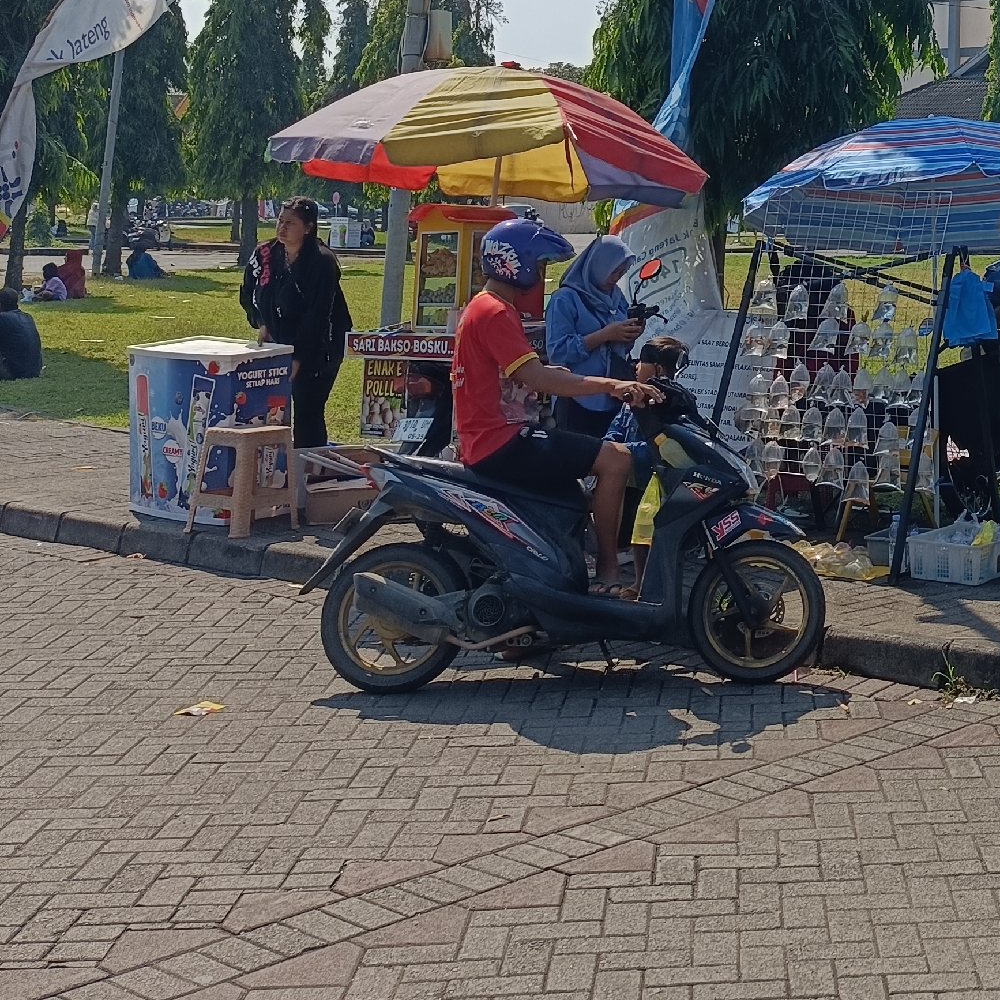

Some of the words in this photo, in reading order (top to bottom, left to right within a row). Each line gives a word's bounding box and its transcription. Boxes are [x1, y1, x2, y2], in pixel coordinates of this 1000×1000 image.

[353, 338, 375, 352] SARI
[377, 340, 411, 353] BAKSO
[237, 369, 267, 381] YOGURT
[268, 366, 289, 378] STICK
[265, 377, 280, 386] HARI
[151, 421, 167, 432] BEKU
[692, 471, 722, 485] HONDA
[710, 509, 741, 542] YSS
